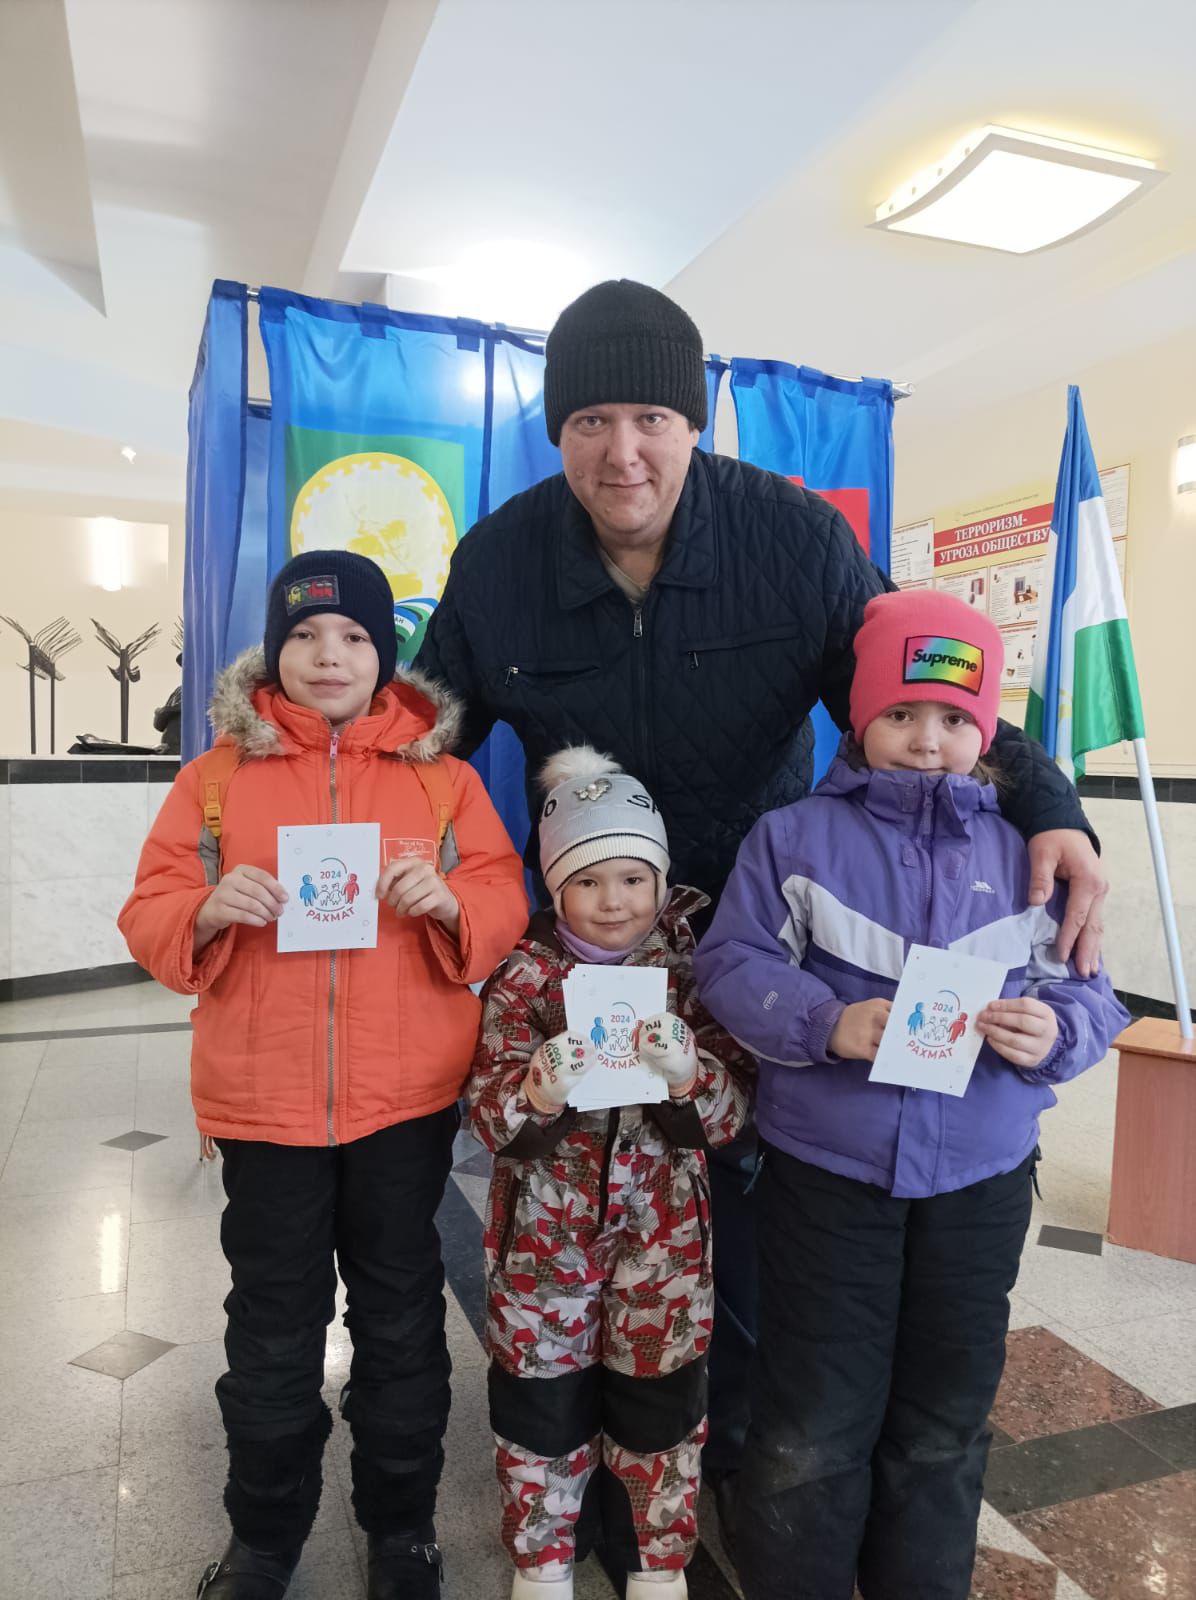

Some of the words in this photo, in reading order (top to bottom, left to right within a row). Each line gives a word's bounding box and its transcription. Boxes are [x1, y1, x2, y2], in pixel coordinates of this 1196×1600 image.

[955, 514, 1028, 542] ТЕРРОРИЗМ-
[939, 545, 980, 563] УГРОЗА
[981, 527, 1050, 554] ОБЩЕСТВУ
[912, 649, 978, 672] Supreme
[319, 870, 342, 879] 2024
[306, 906, 355, 922] РАХМАТ
[932, 1001, 954, 1013] 2024
[610, 1014, 631, 1023] 2024
[906, 1039, 953, 1060] РАХМАТ
